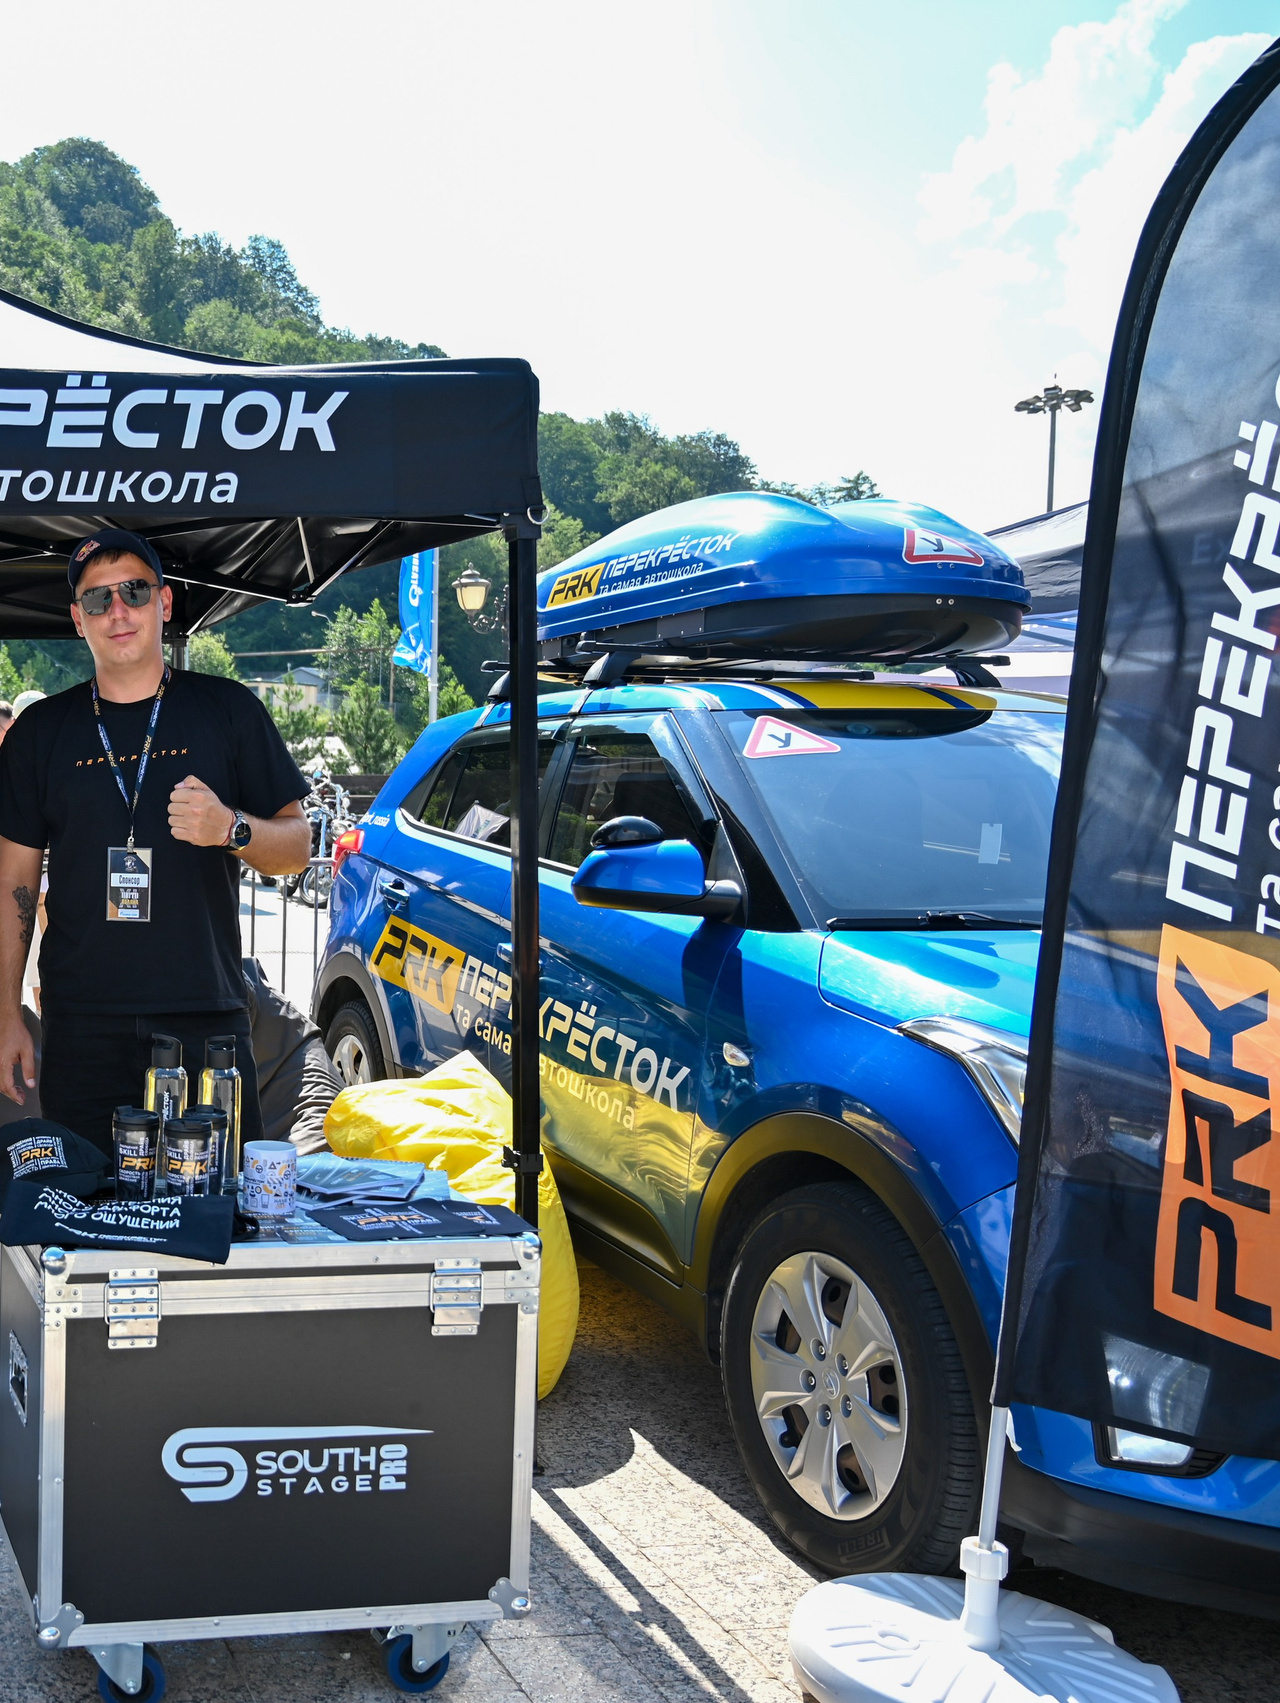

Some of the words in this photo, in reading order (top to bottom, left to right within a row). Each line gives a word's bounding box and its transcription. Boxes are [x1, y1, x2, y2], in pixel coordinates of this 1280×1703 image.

[603, 532, 742, 580] ПЕРЕКРЁСТОК
[550, 568, 602, 604] PRK
[612, 577, 641, 593] самая
[644, 562, 704, 585] автошкола
[767, 732, 792, 749] У
[75, 748, 188, 767] ПЕРКРСТОК
[374, 923, 455, 1004] PRK
[455, 1003, 471, 1030] та
[475, 1015, 513, 1056] сама
[538, 1055, 635, 1131] втошкола
[119, 1148, 138, 1157] SKILL
[1173, 954, 1272, 1332] PRK
[21, 1147, 53, 1164] PRK
[169, 1160, 208, 1175] PRK
[91, 1211, 180, 1230] ОЩУЩЕНИЙ
[357, 1214, 423, 1226] PRK
[255, 1447, 376, 1475] SOUTH
[379, 1444, 408, 1491] PRO
[257, 1475, 373, 1496] STAGE
